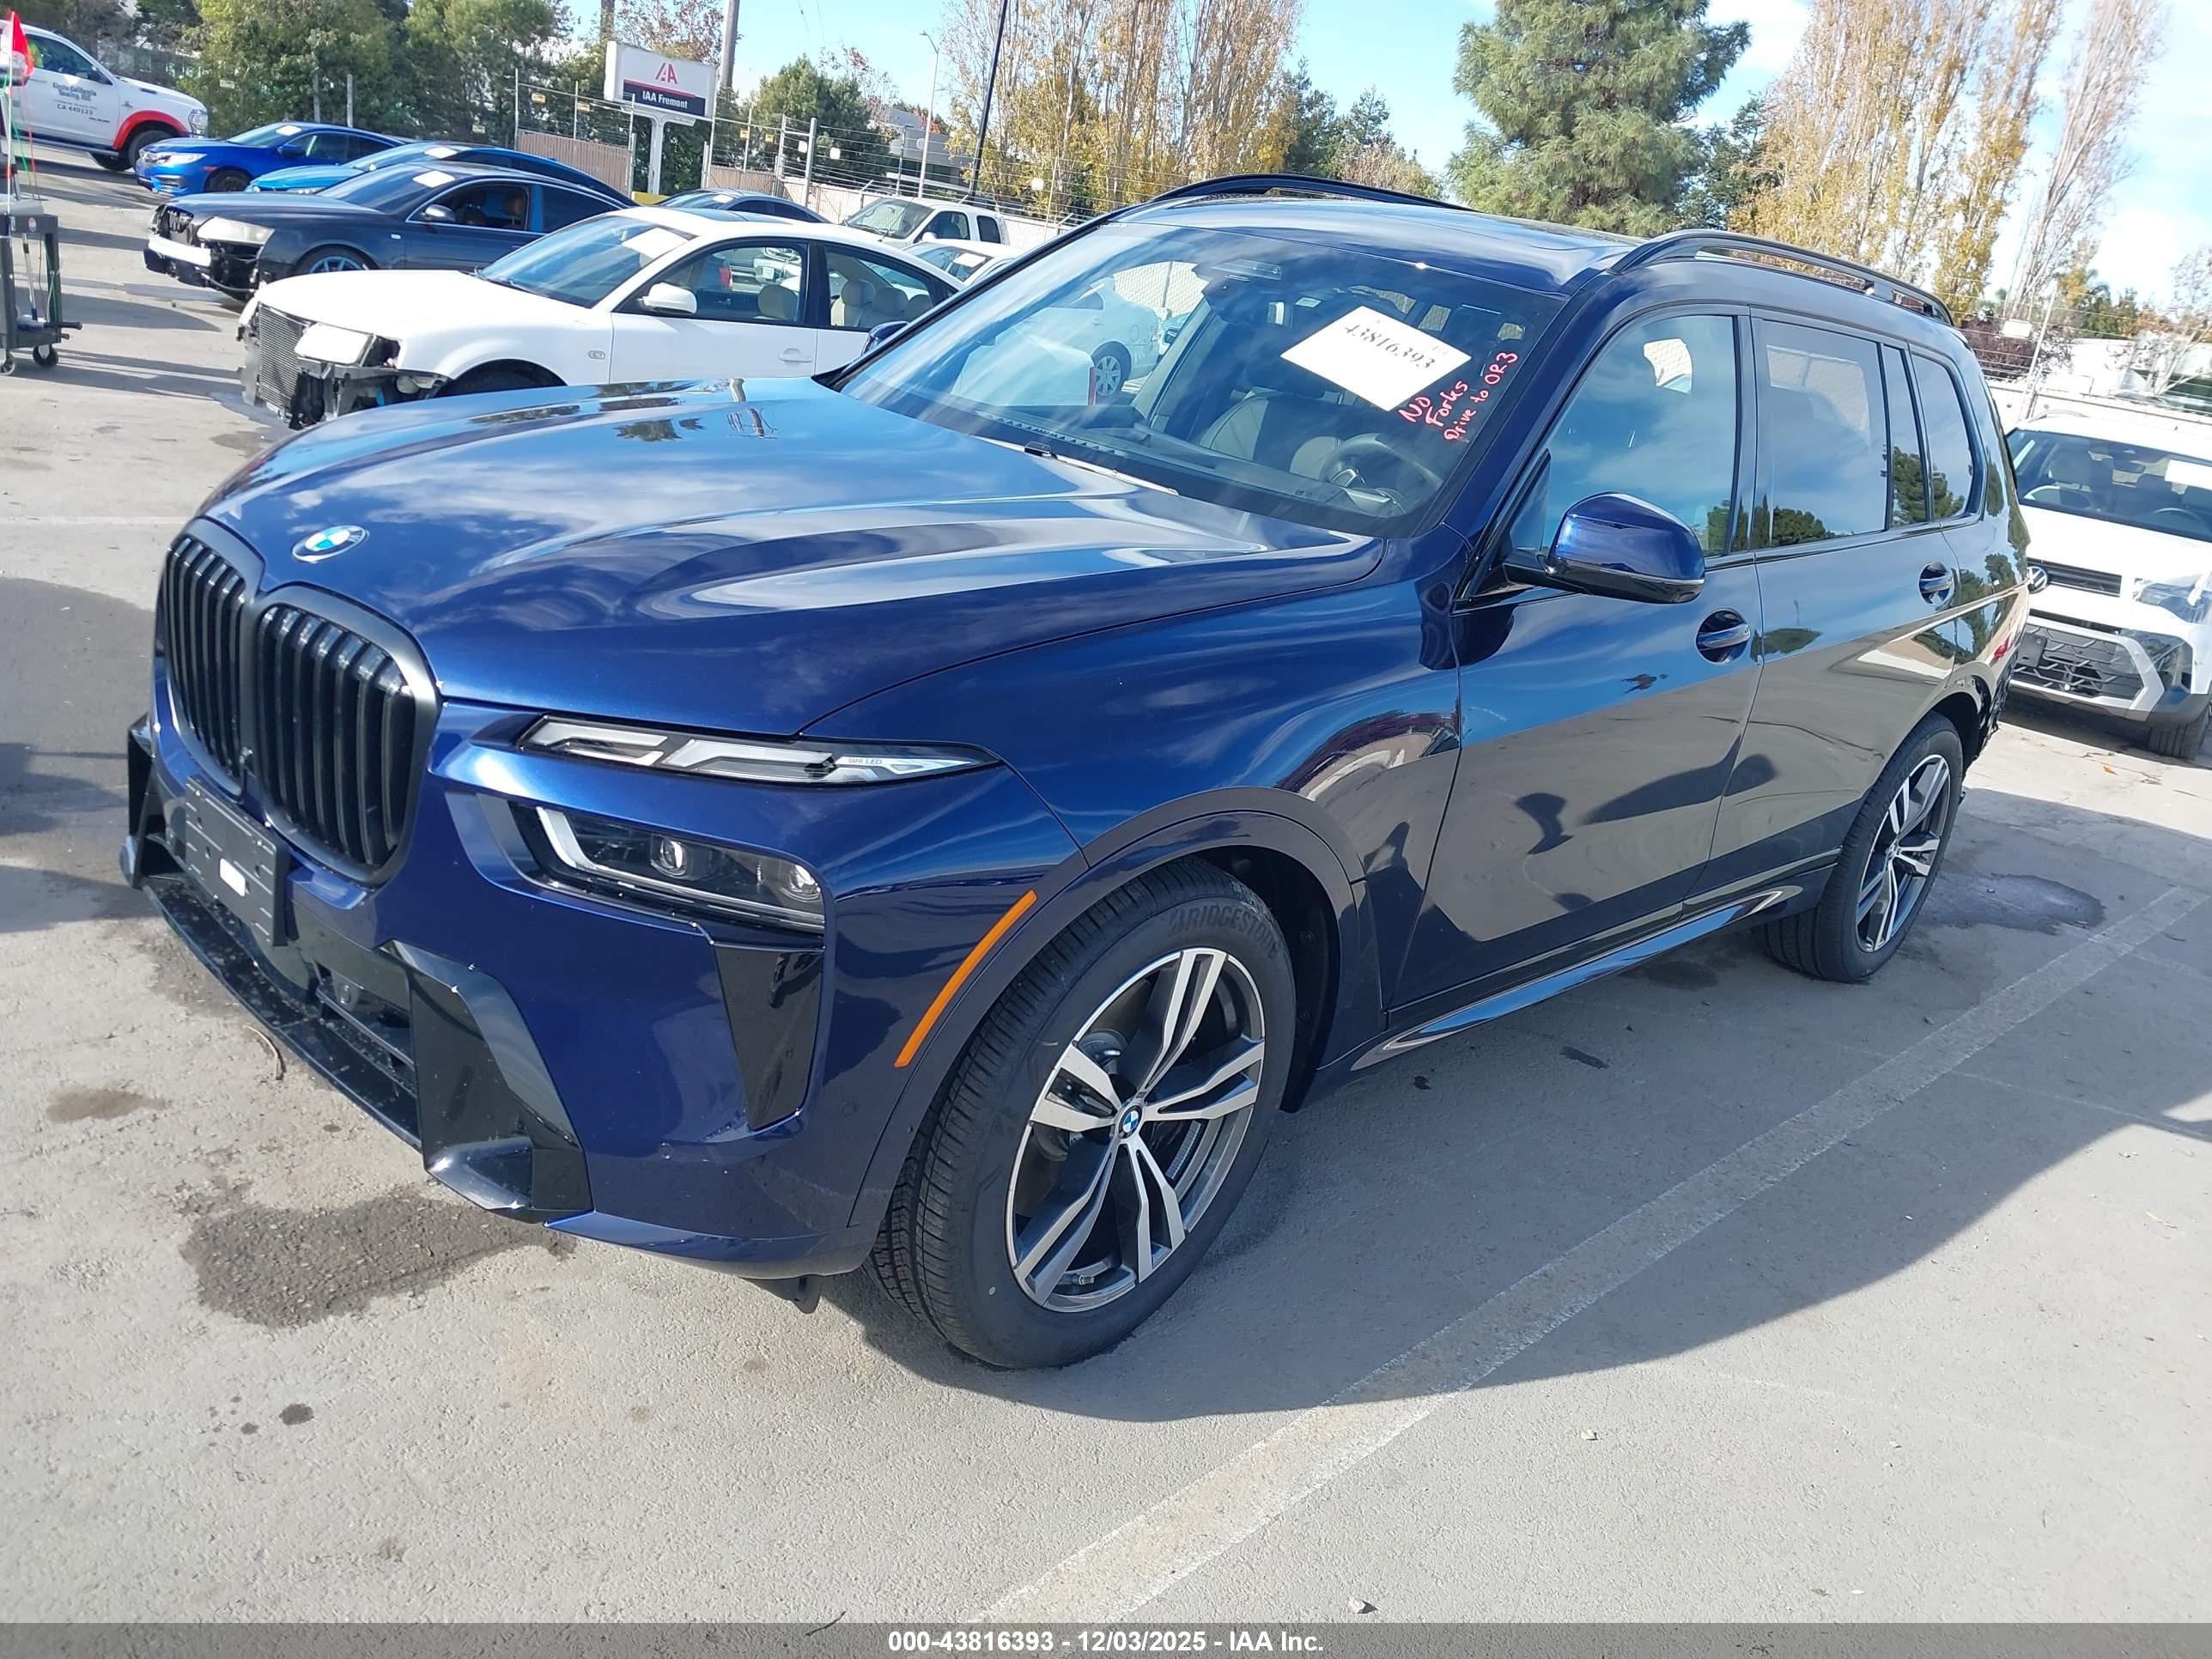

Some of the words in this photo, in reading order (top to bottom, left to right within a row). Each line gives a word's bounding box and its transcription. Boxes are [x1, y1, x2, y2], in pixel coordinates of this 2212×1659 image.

[642, 90, 657, 101] IAA
[658, 94, 688, 109] Fremont
[1345, 324, 1437, 369] 43816393
[1469, 390, 1490, 404] to
